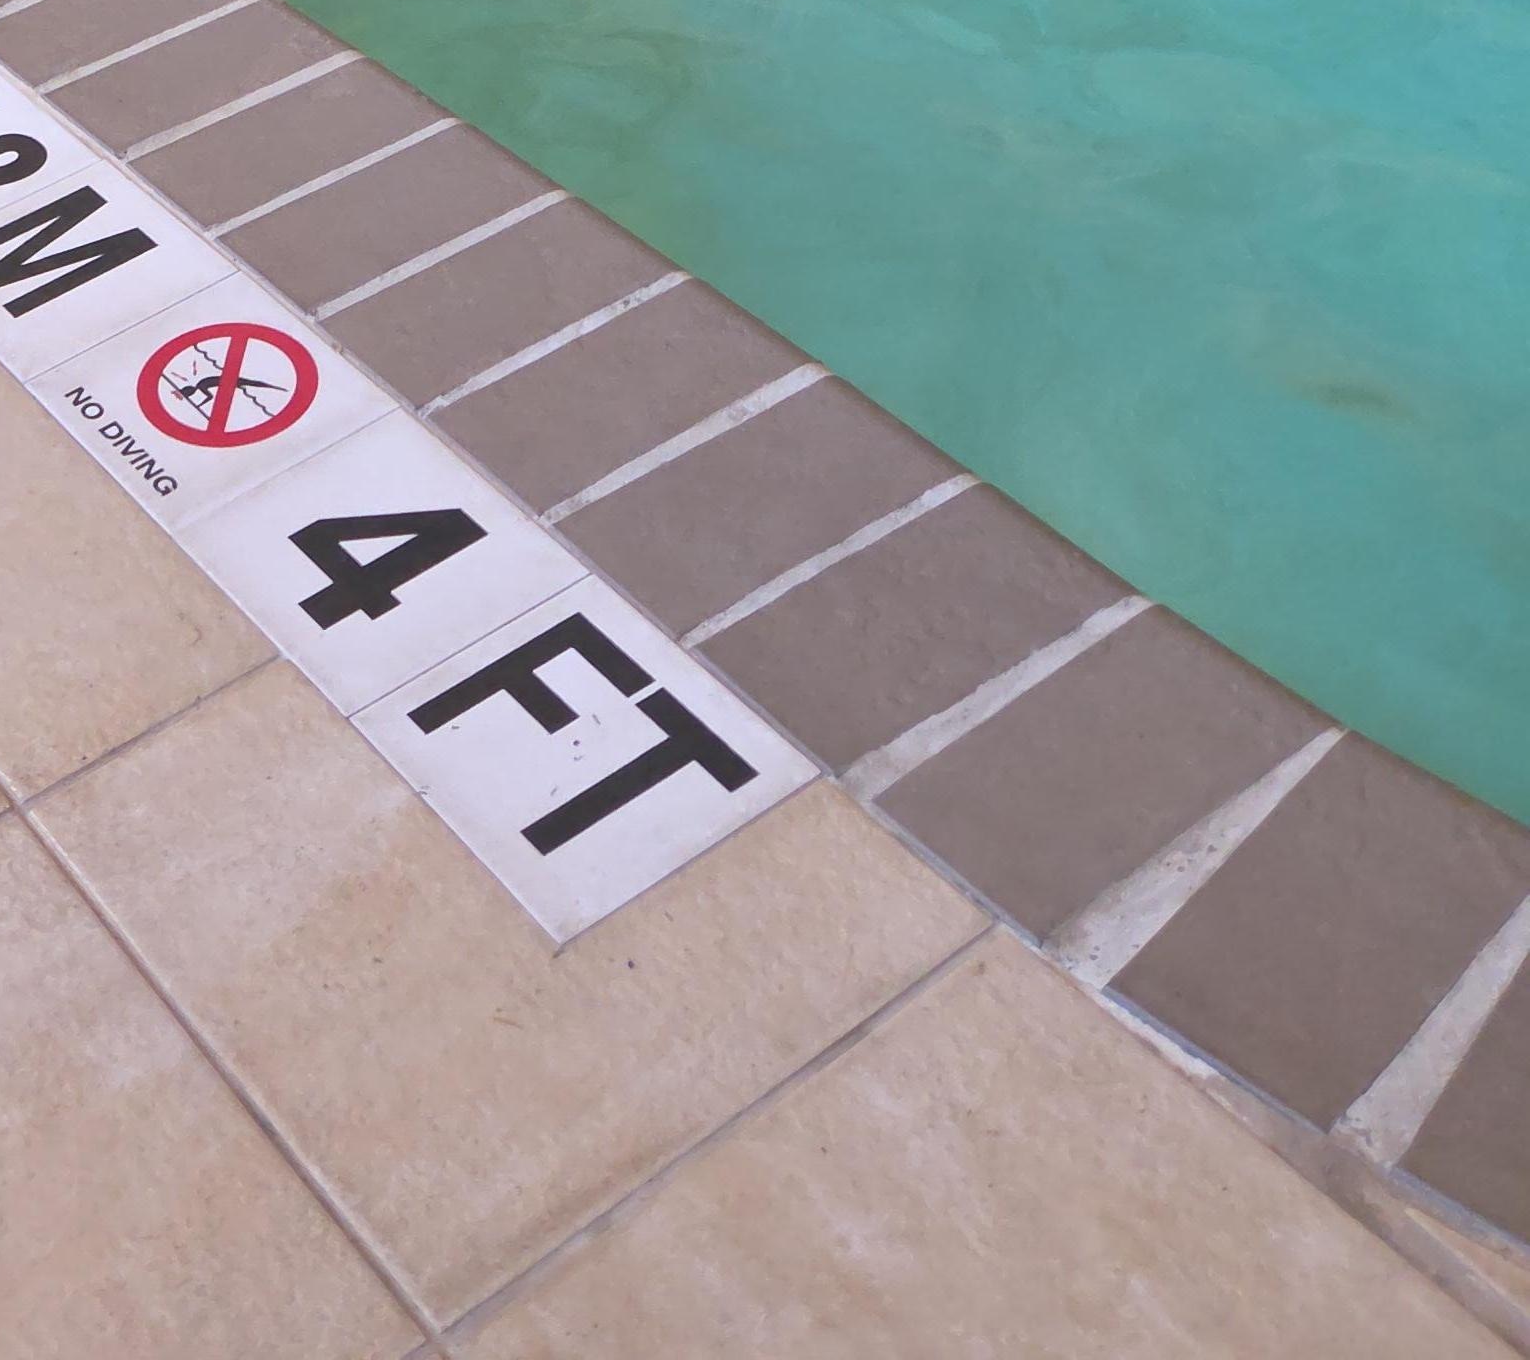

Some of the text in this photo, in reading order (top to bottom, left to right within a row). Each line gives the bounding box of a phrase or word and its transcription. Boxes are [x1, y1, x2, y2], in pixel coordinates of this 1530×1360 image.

[64, 386, 178, 496] NO DIVING
[288, 508, 760, 856] 4 FT
